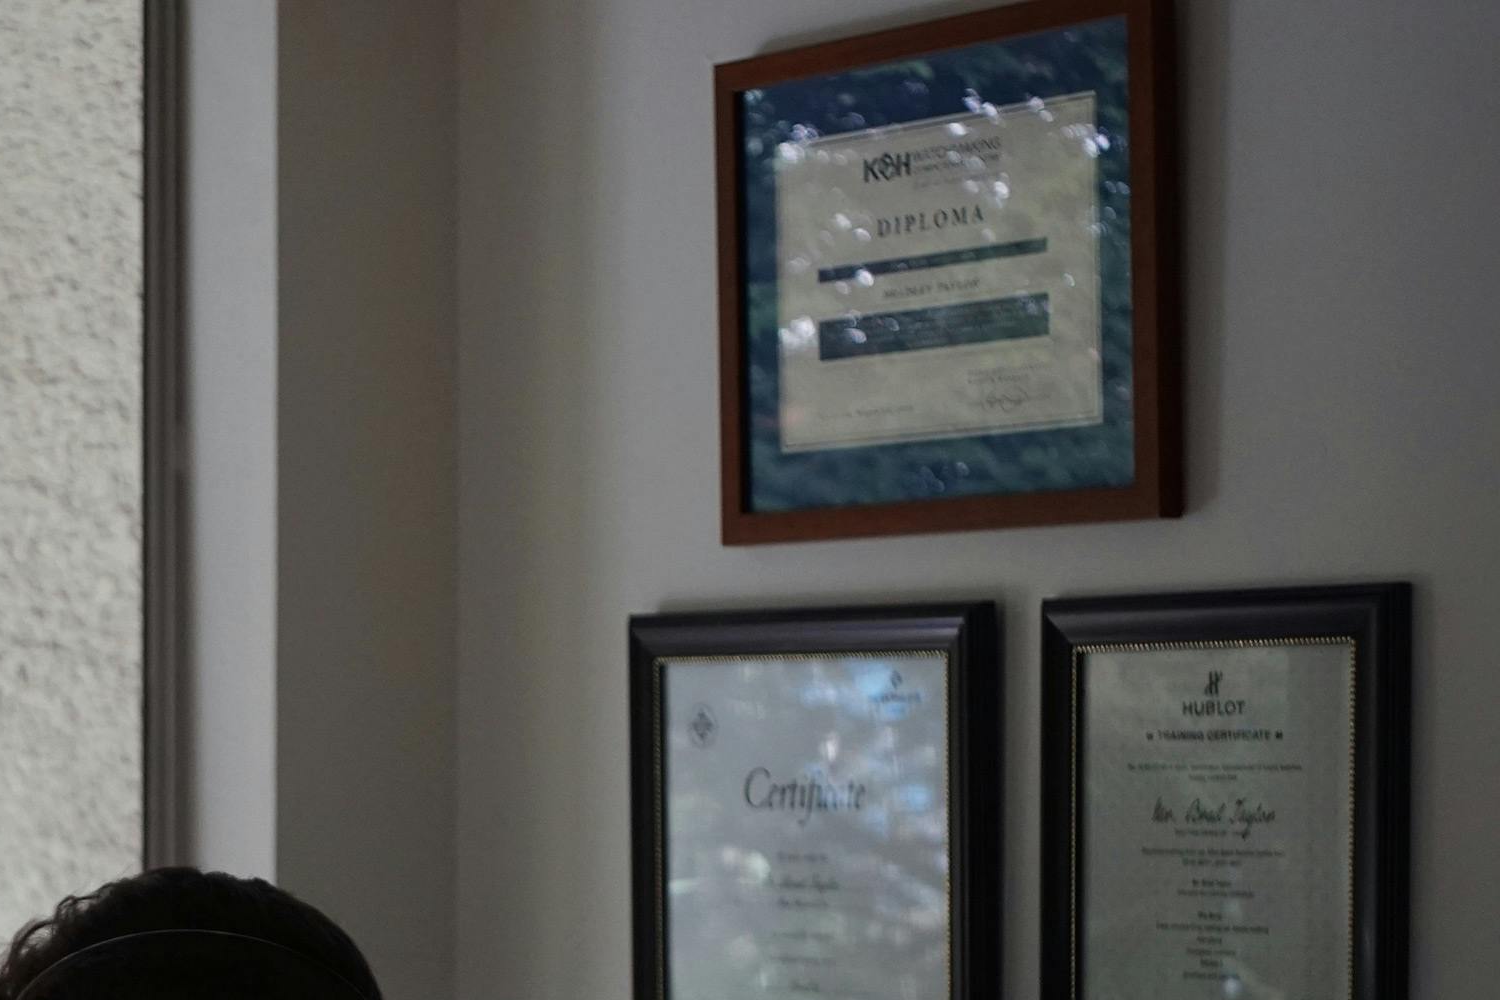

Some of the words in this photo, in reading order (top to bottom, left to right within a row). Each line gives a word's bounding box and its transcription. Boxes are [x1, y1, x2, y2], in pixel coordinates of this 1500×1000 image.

[876, 203, 985, 238] DIPLOMA
[1182, 700, 1246, 716] HUBLOT
[1157, 729, 1205, 742] TRAINING
[1206, 729, 1272, 742] CERTIFICATE
